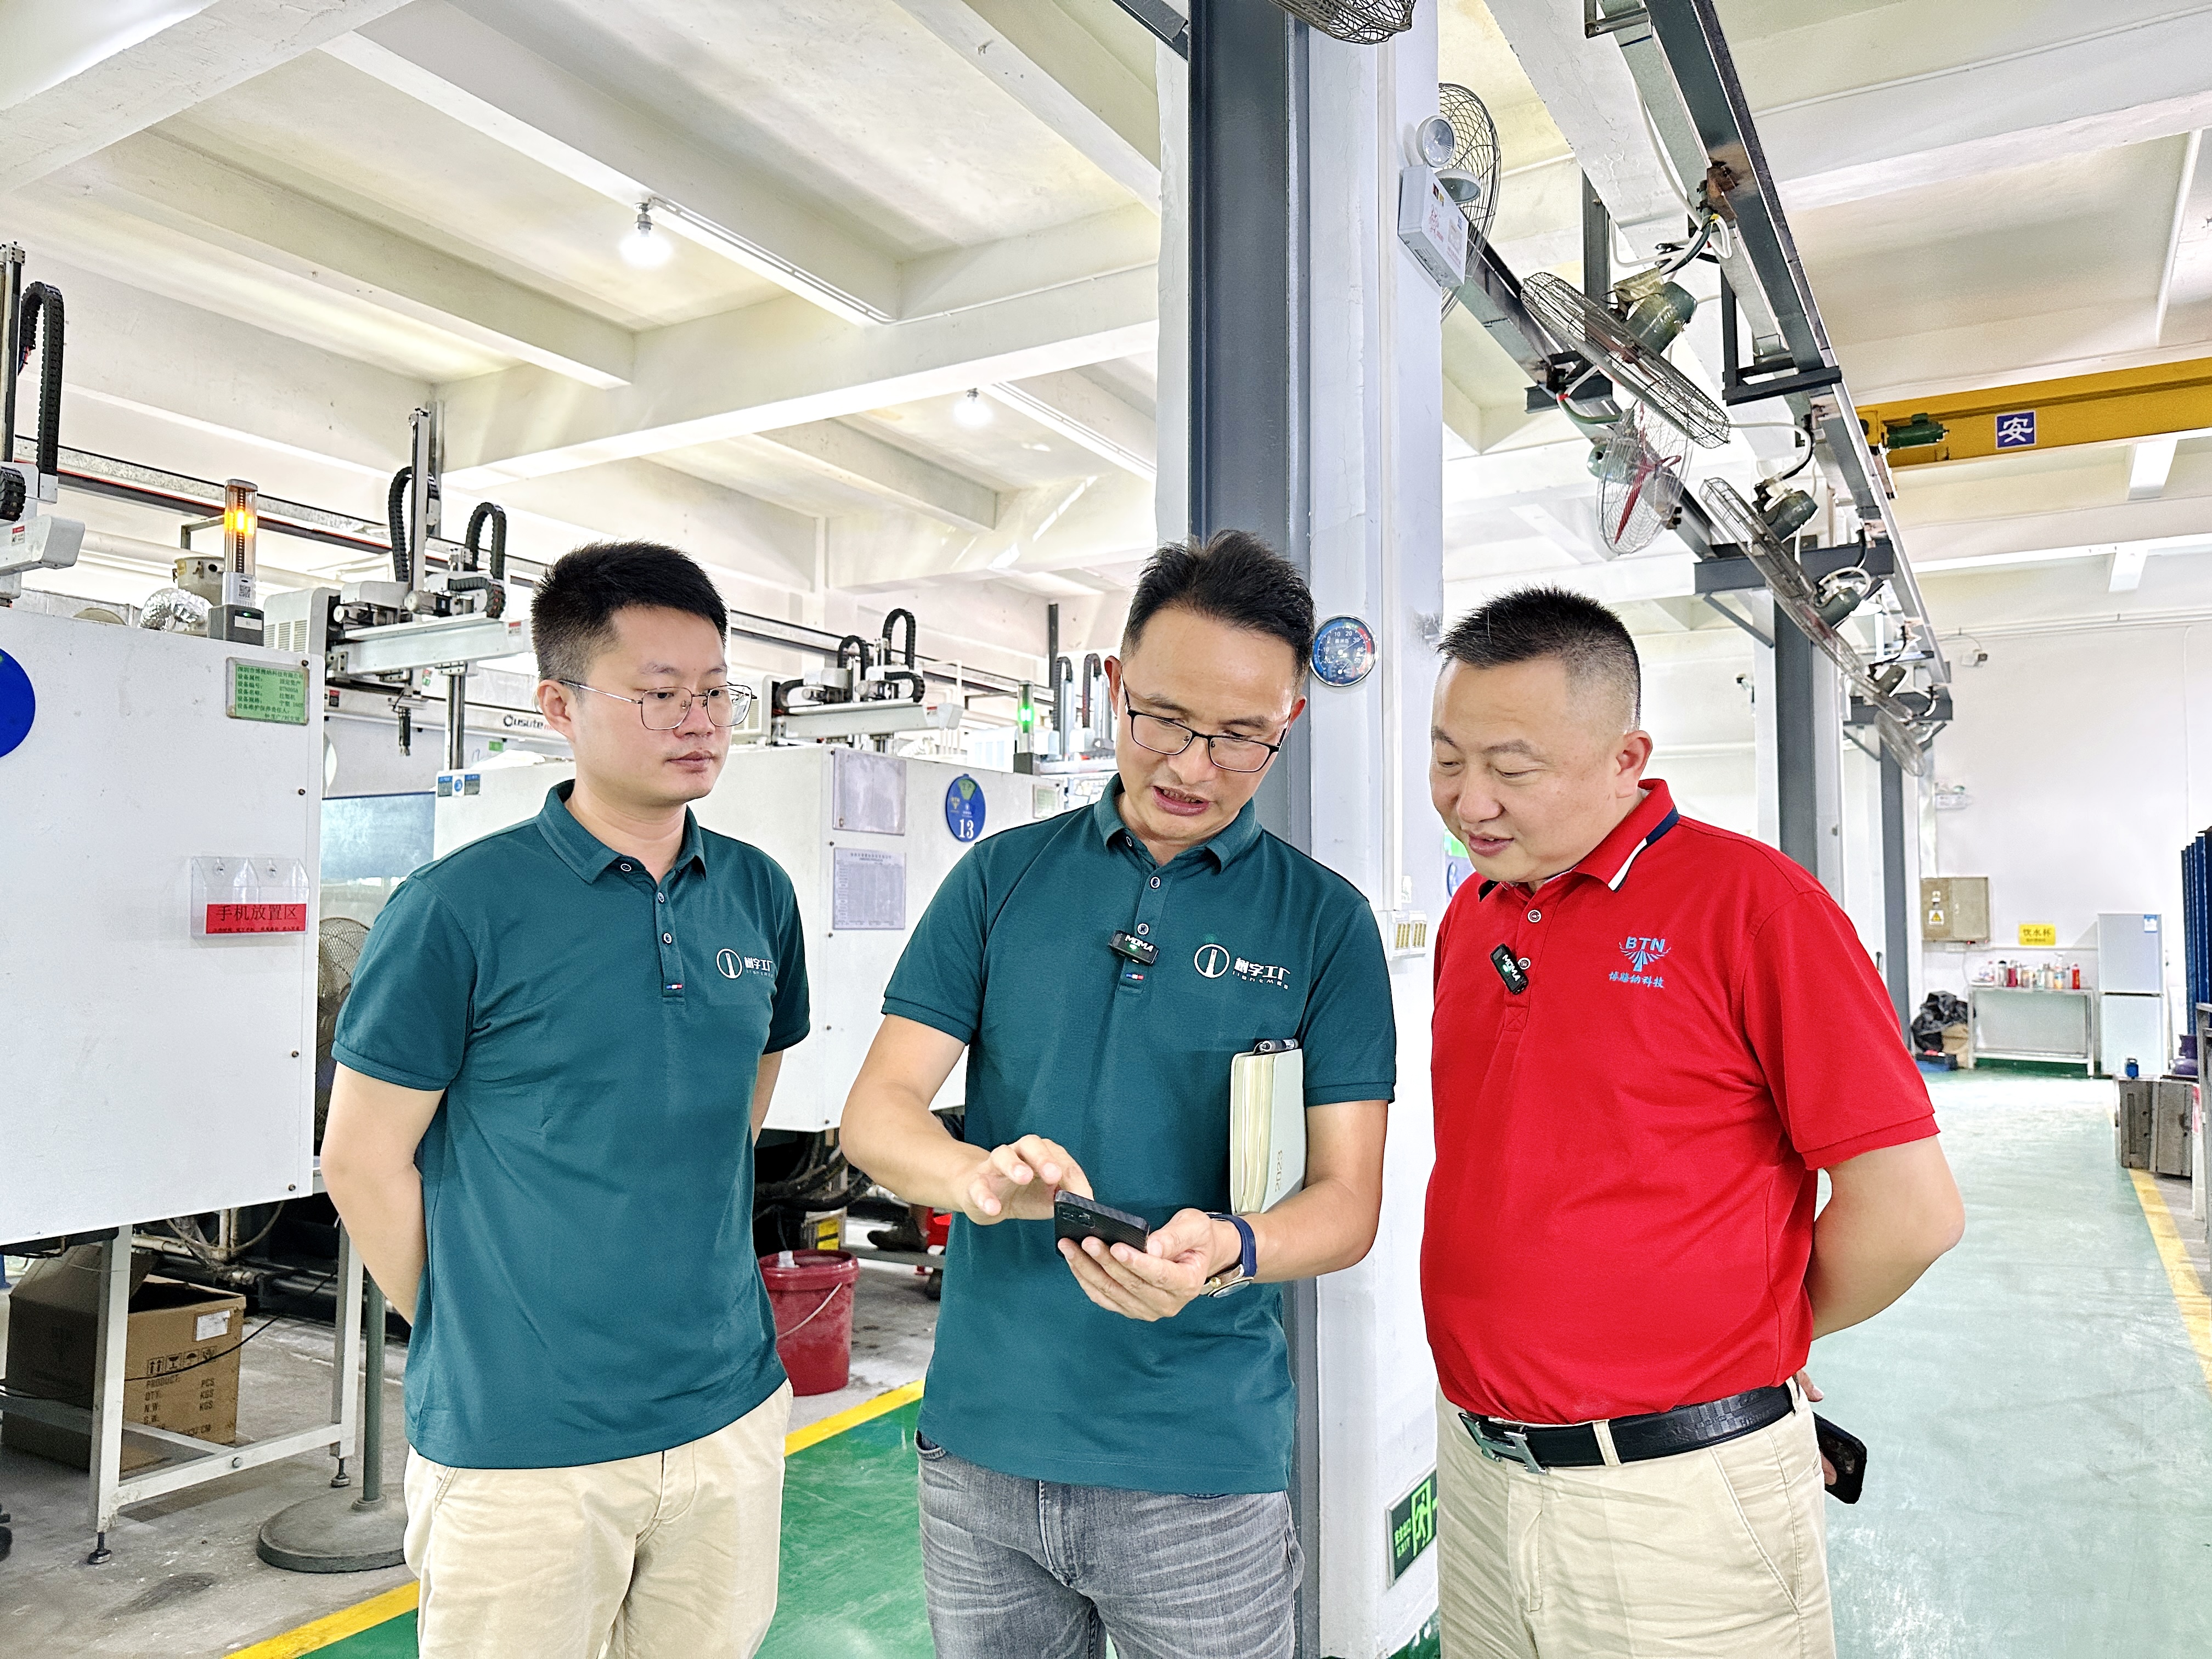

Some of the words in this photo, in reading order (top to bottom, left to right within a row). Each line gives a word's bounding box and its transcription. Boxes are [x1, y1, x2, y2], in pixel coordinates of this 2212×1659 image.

[1998, 417, 2033, 443] 安
[958, 819, 974, 839] 13
[216, 905, 298, 921] 手机放置区
[1625, 936, 1666, 953] BTN
[200, 1389, 215, 1400] KGS
[199, 1400, 214, 1412] KGS
